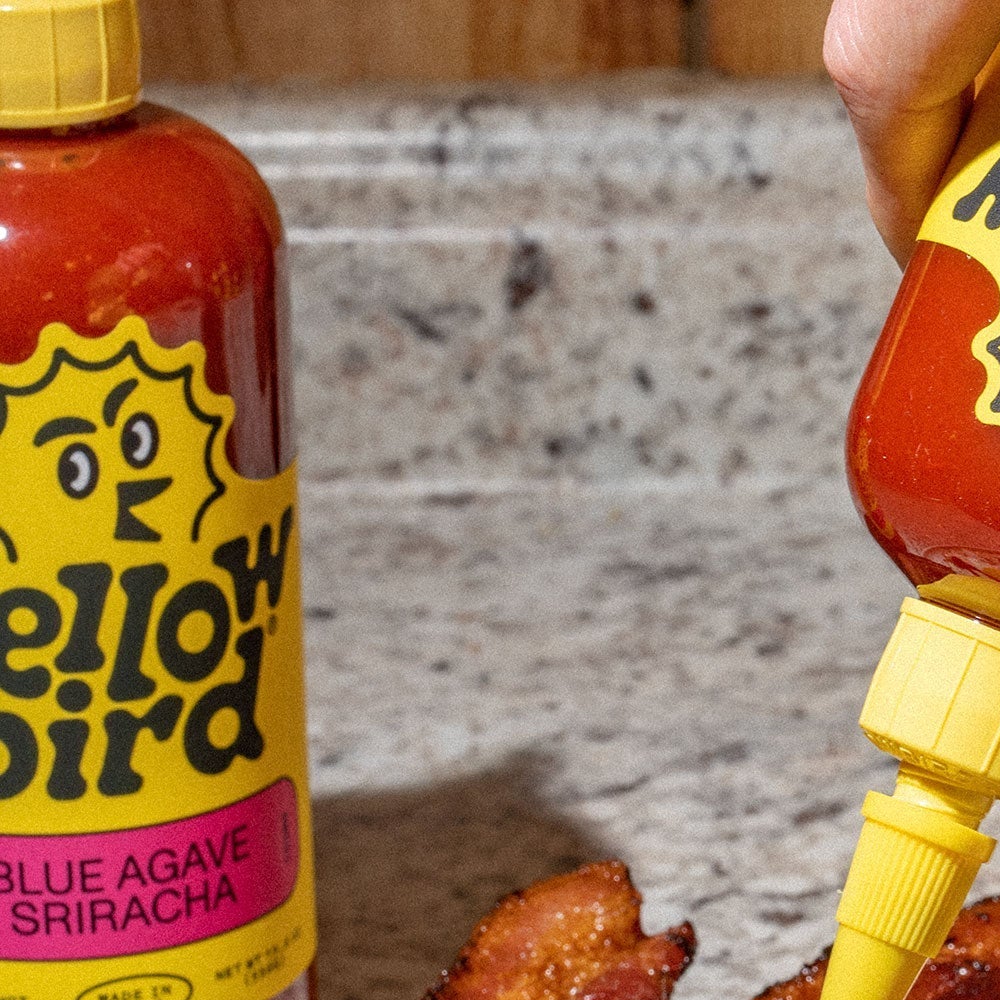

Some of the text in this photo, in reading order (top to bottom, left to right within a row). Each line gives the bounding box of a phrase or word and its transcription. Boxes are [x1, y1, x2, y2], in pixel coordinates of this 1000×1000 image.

[0, 858, 104, 896] BLUE
[117, 824, 250, 890] AGAVE
[11, 874, 238, 936] SRIRACHA
[152, 985, 173, 998] IN
